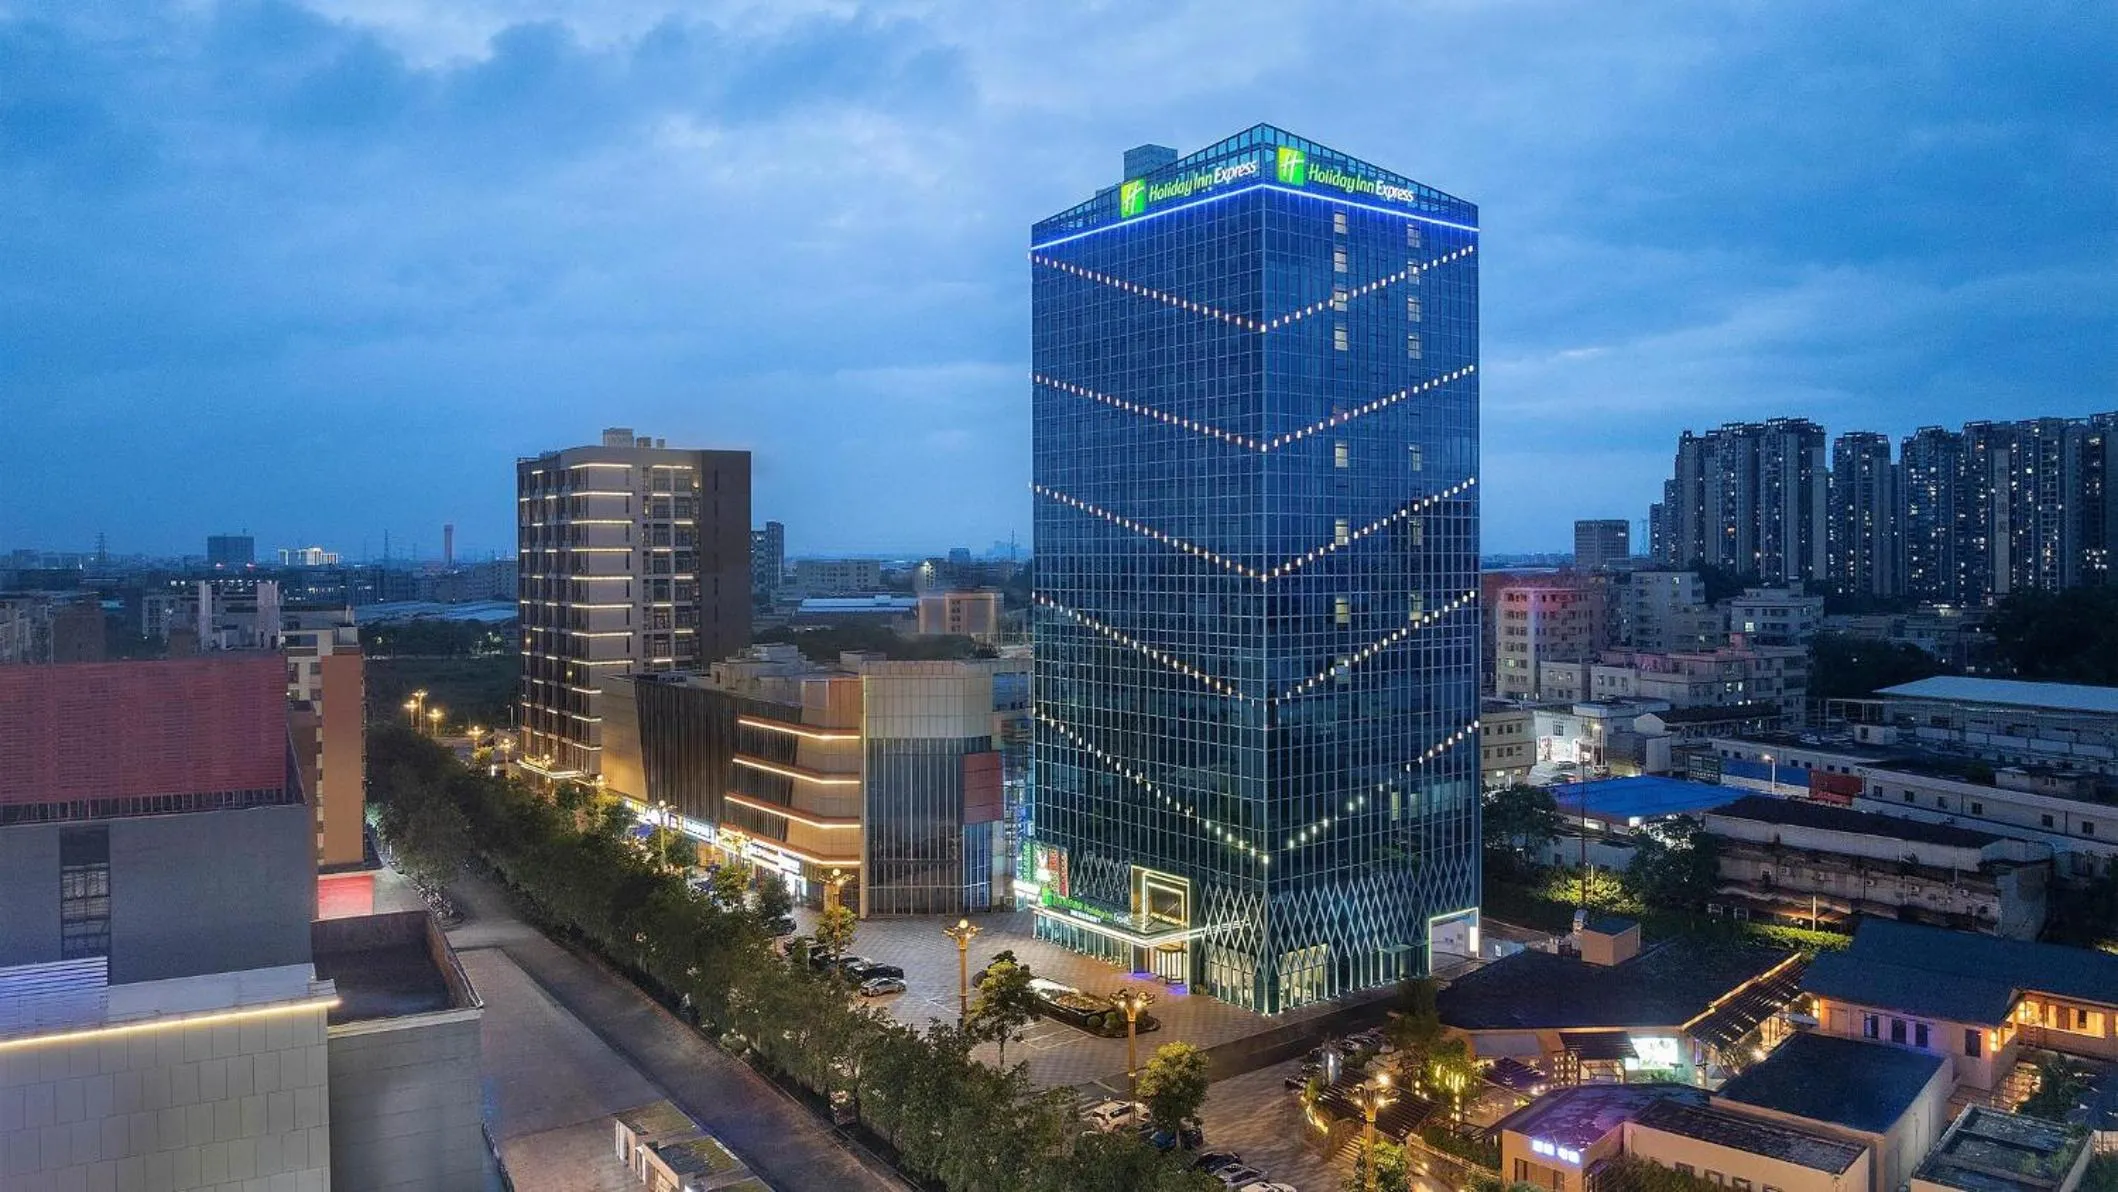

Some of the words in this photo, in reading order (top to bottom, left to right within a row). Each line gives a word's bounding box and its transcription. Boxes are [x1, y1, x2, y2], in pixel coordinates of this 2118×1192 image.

[1149, 177, 1193, 202] Holiday
[1193, 172, 1213, 190] Inn
[1214, 160, 1257, 184] Express
[1308, 163, 1355, 193] Holiday
[1356, 175, 1375, 194] Inn
[1376, 180, 1414, 203] Express
